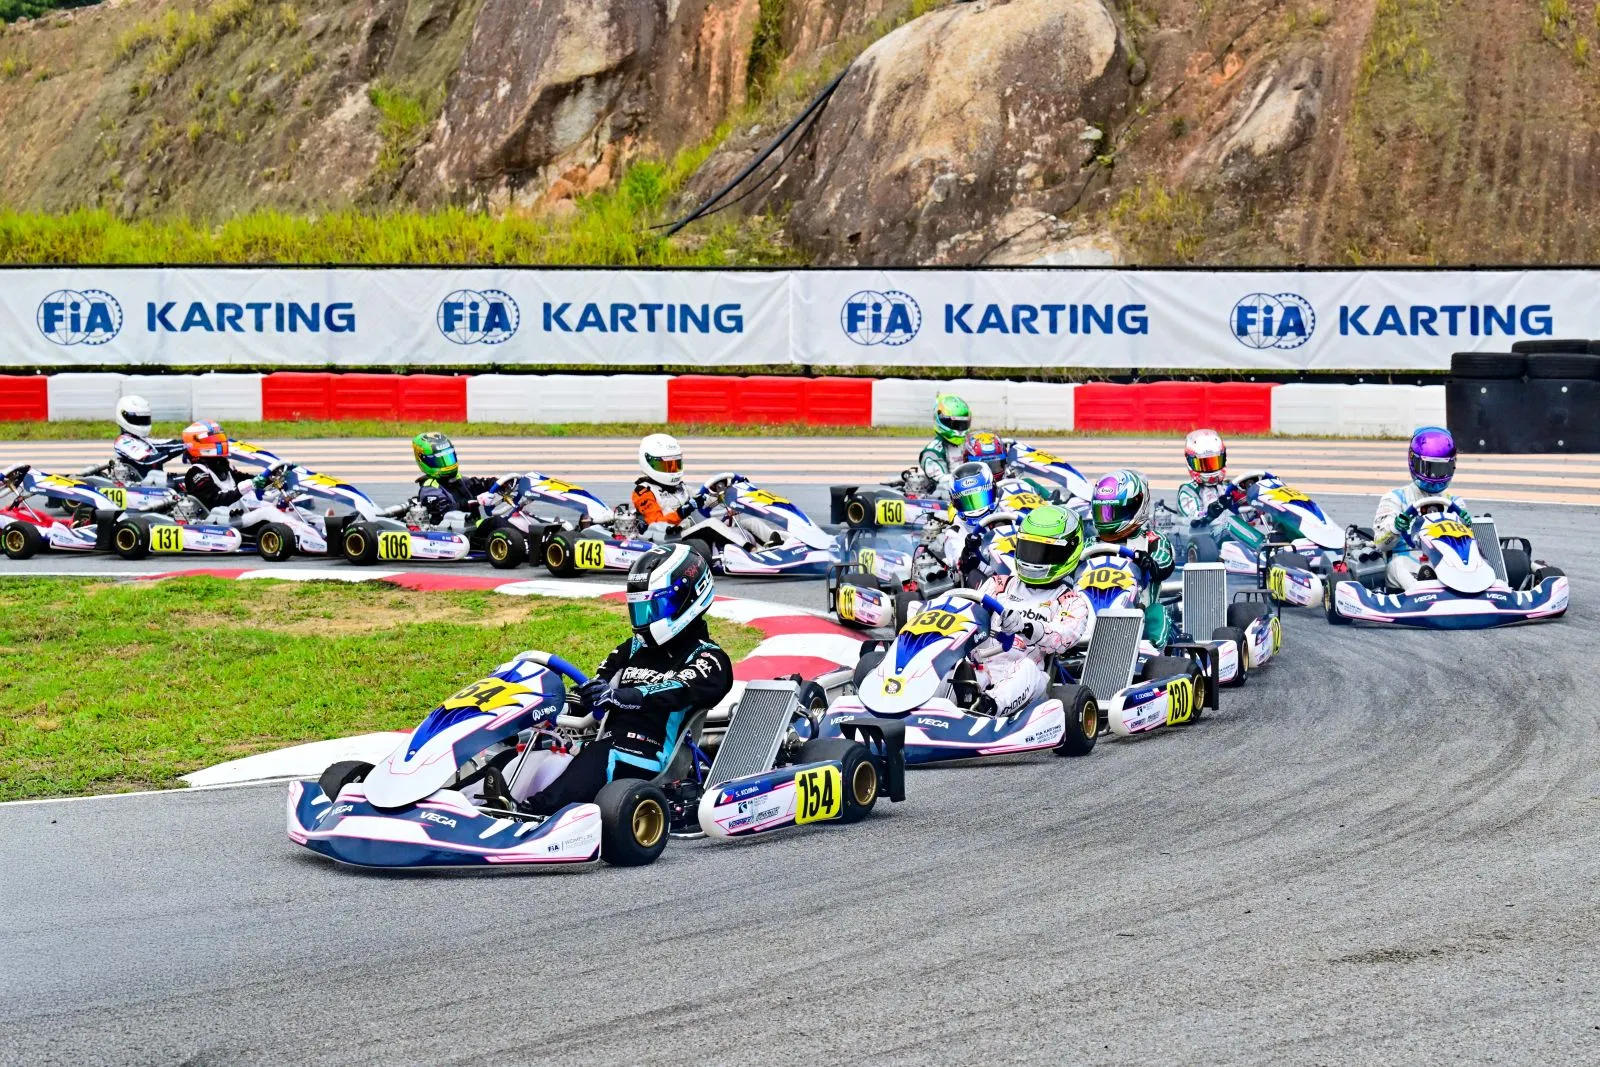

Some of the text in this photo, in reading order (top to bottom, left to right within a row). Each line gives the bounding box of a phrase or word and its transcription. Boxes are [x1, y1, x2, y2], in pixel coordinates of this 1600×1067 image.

[148, 302, 355, 333] KARTING
[543, 303, 743, 333] KARTING
[945, 303, 1148, 335] KARTING
[1340, 305, 1552, 337] KARTING
[882, 502, 902, 524] 150
[156, 527, 179, 549] 131
[382, 534, 407, 560] 106
[579, 541, 602, 567] 143
[1086, 569, 1126, 587] 102
[1413, 594, 1437, 603] VEGA
[1486, 593, 1507, 601] VEGA
[911, 611, 956, 630] 130
[454, 681, 506, 706] 54
[1169, 681, 1188, 722] 130
[830, 715, 854, 725] VEGA
[917, 717, 949, 729] VEGA
[799, 770, 834, 818] 154
[331, 804, 353, 815] VEGA
[419, 811, 457, 828] VEGA
